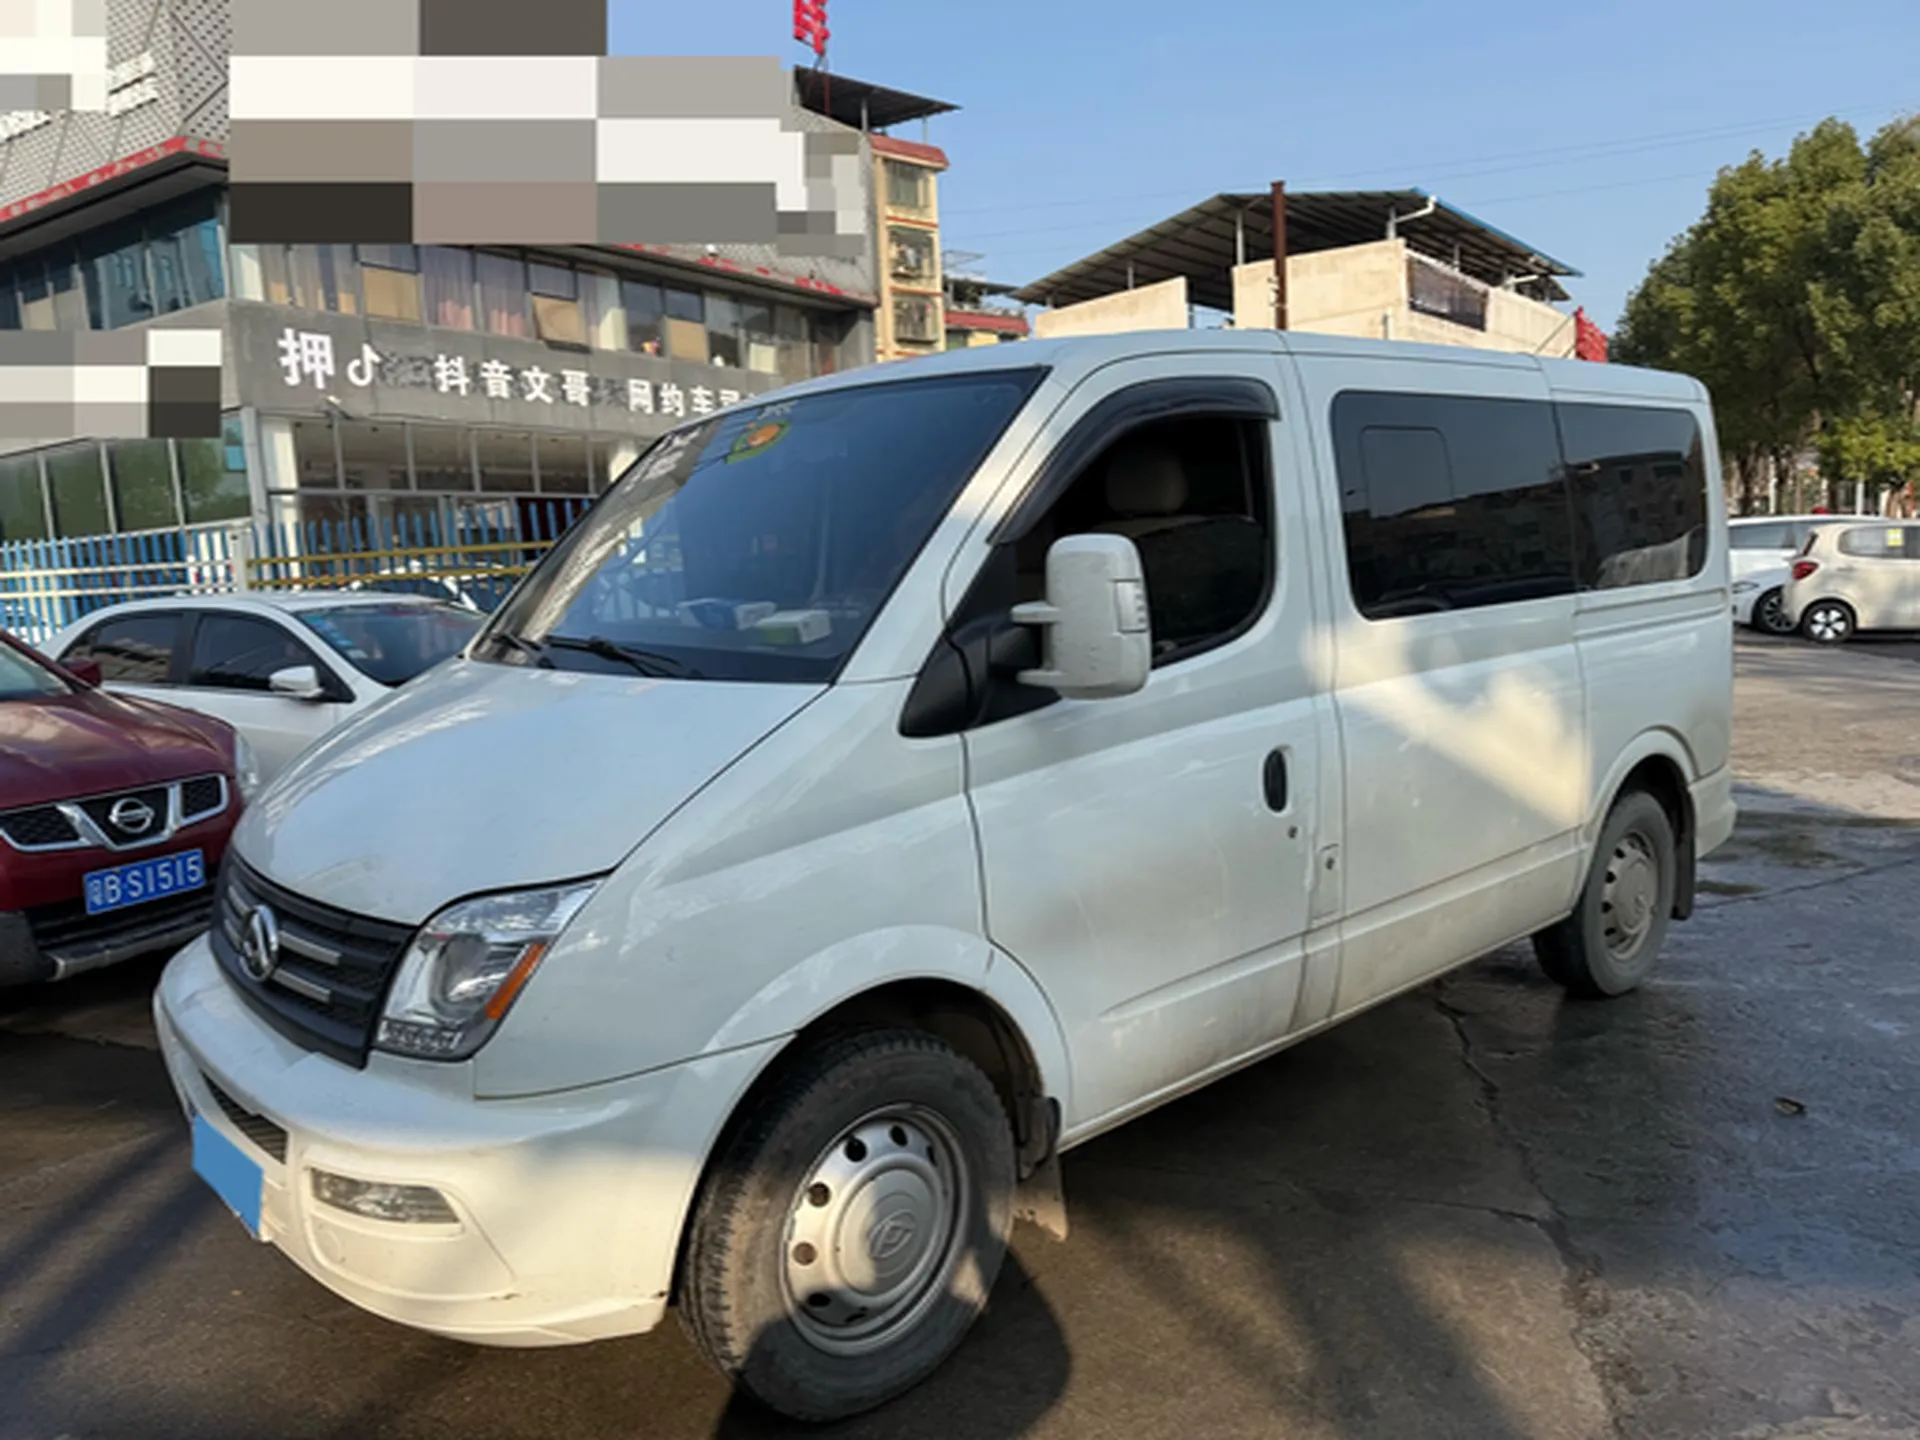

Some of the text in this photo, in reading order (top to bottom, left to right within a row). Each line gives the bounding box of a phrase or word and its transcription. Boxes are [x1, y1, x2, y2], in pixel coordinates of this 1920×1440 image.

[277, 327, 335, 390] 押
[433, 353, 756, 417] 抖音文哥 网约车司
